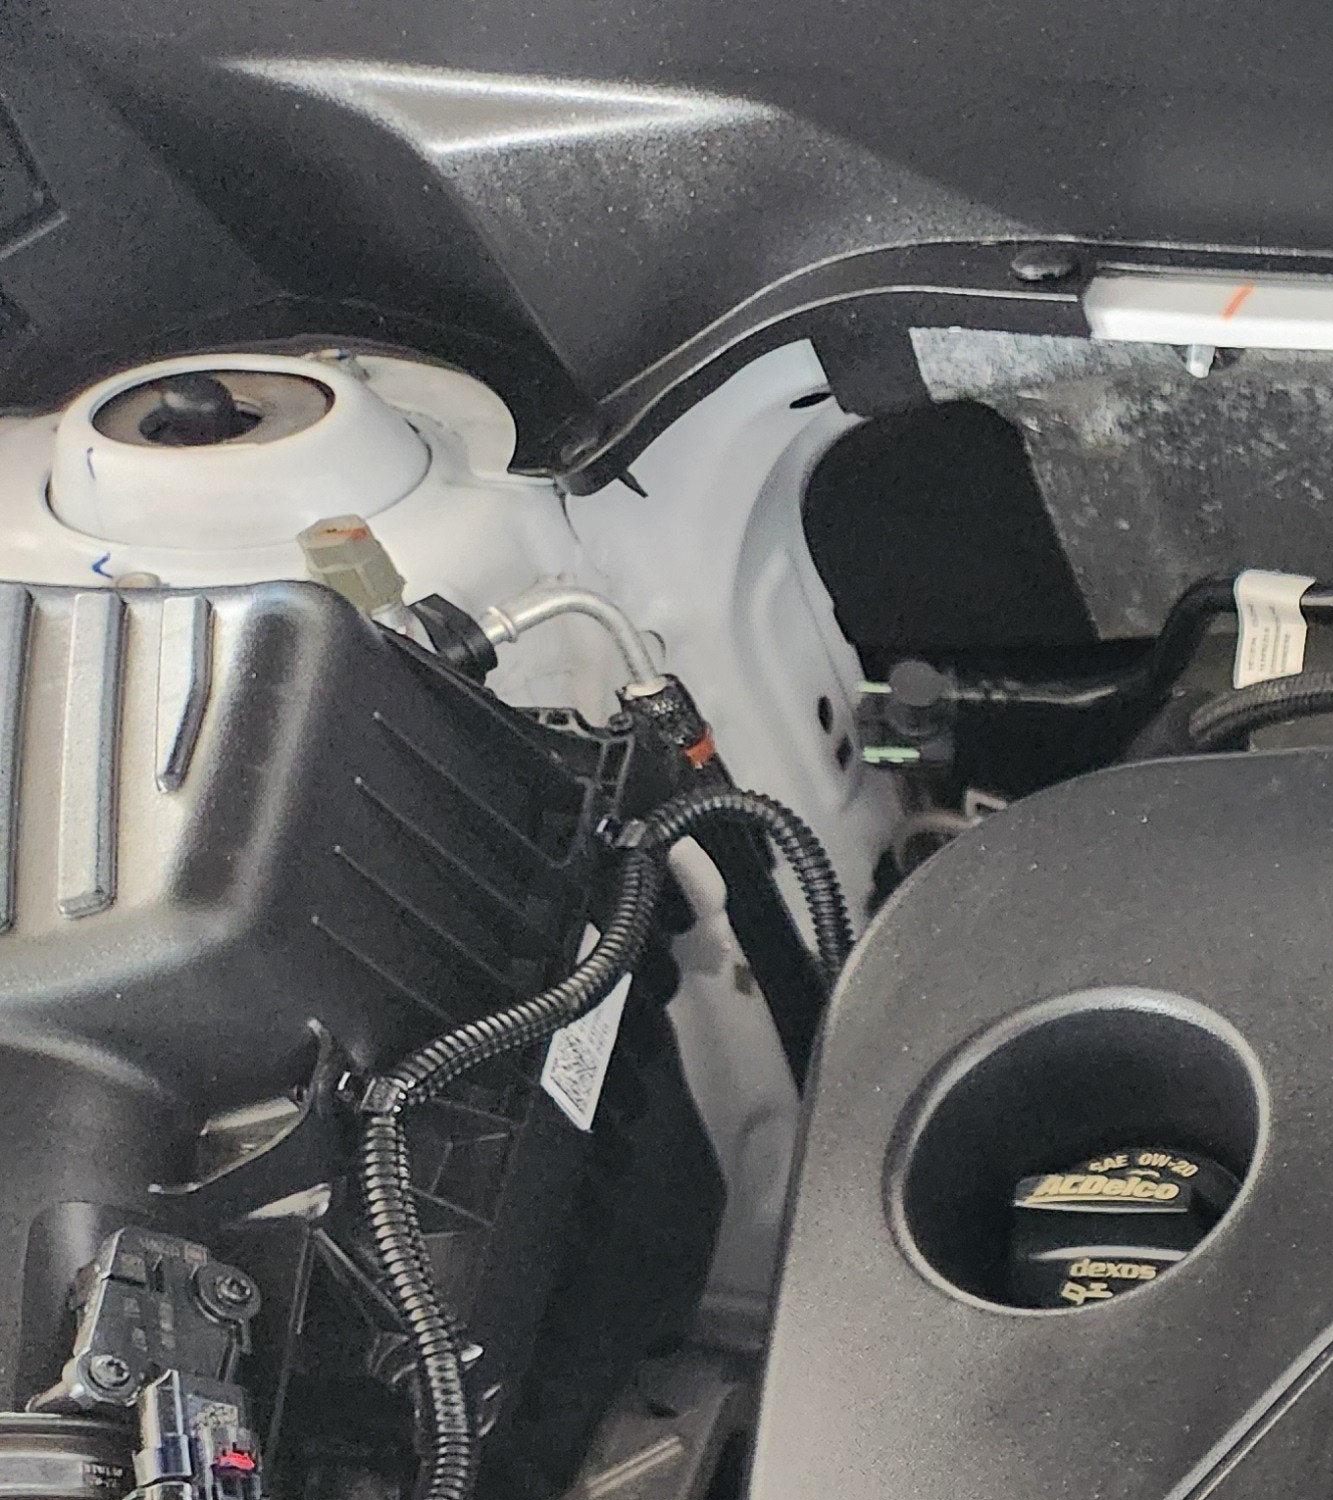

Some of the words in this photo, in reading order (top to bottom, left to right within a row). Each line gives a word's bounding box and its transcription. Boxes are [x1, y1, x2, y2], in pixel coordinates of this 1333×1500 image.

[1087, 1154, 1130, 1173] SAE
[1033, 1174, 1180, 1200] ACDelco
[1069, 1258, 1157, 1280] dexos
